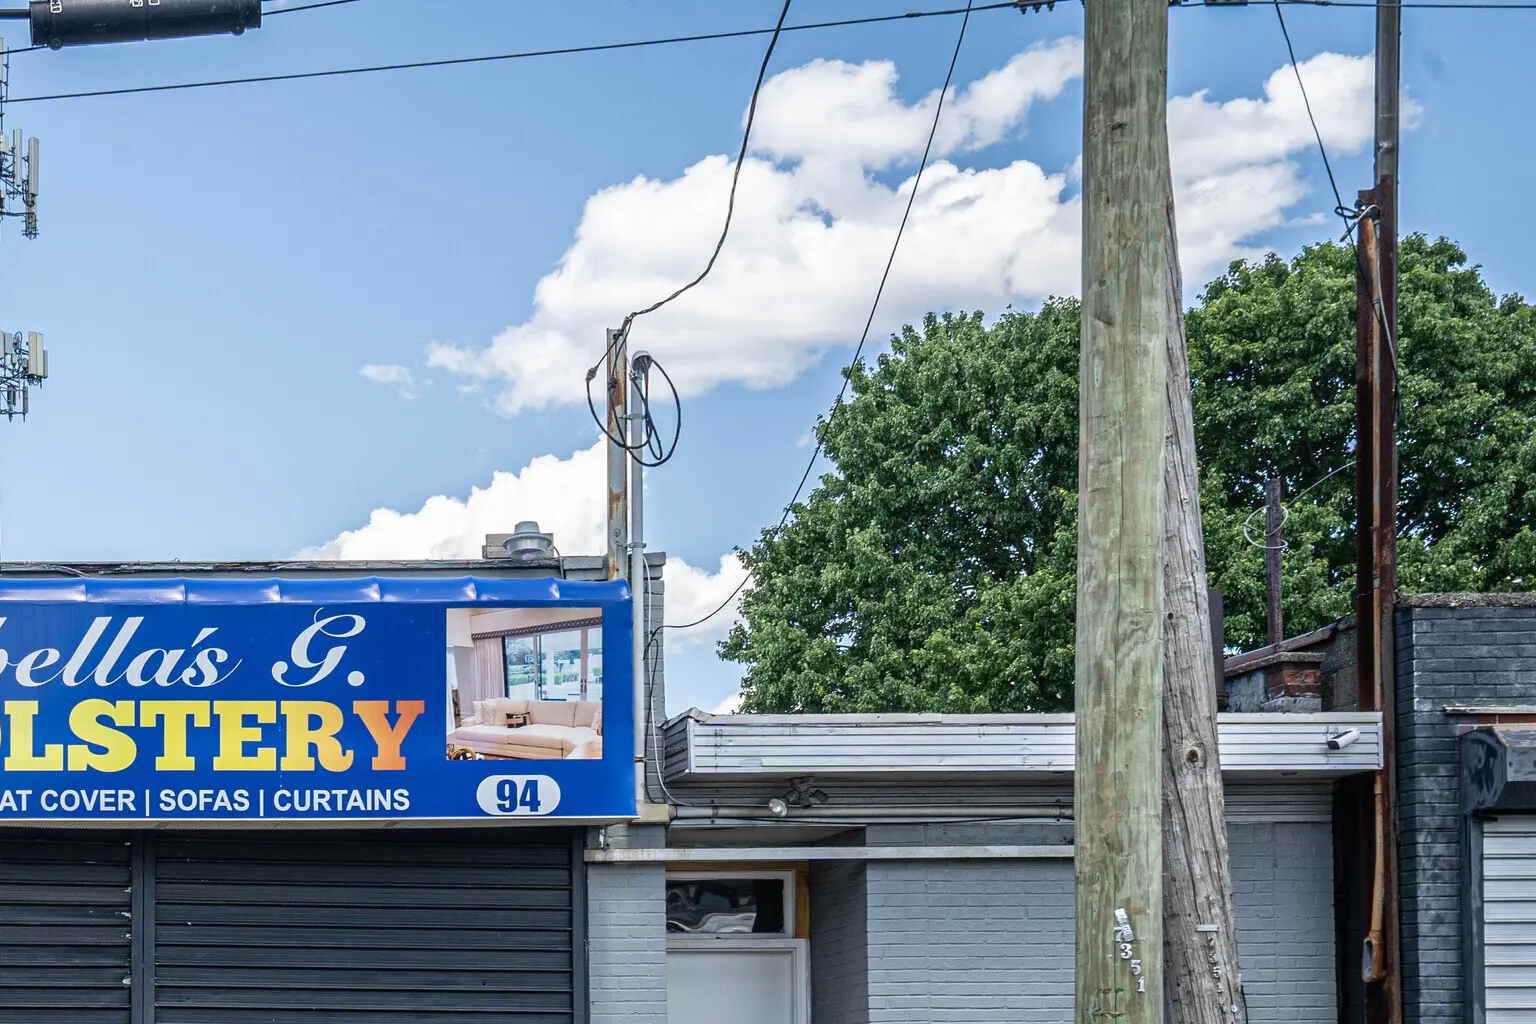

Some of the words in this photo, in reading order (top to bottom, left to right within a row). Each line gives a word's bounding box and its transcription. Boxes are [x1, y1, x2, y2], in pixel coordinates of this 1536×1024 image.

[271, 607, 366, 687] G.
[40, 789, 137, 812] COVER
[159, 789, 250, 812] SOFAS
[273, 789, 410, 812] CURTAINS
[496, 778, 542, 813] 94
